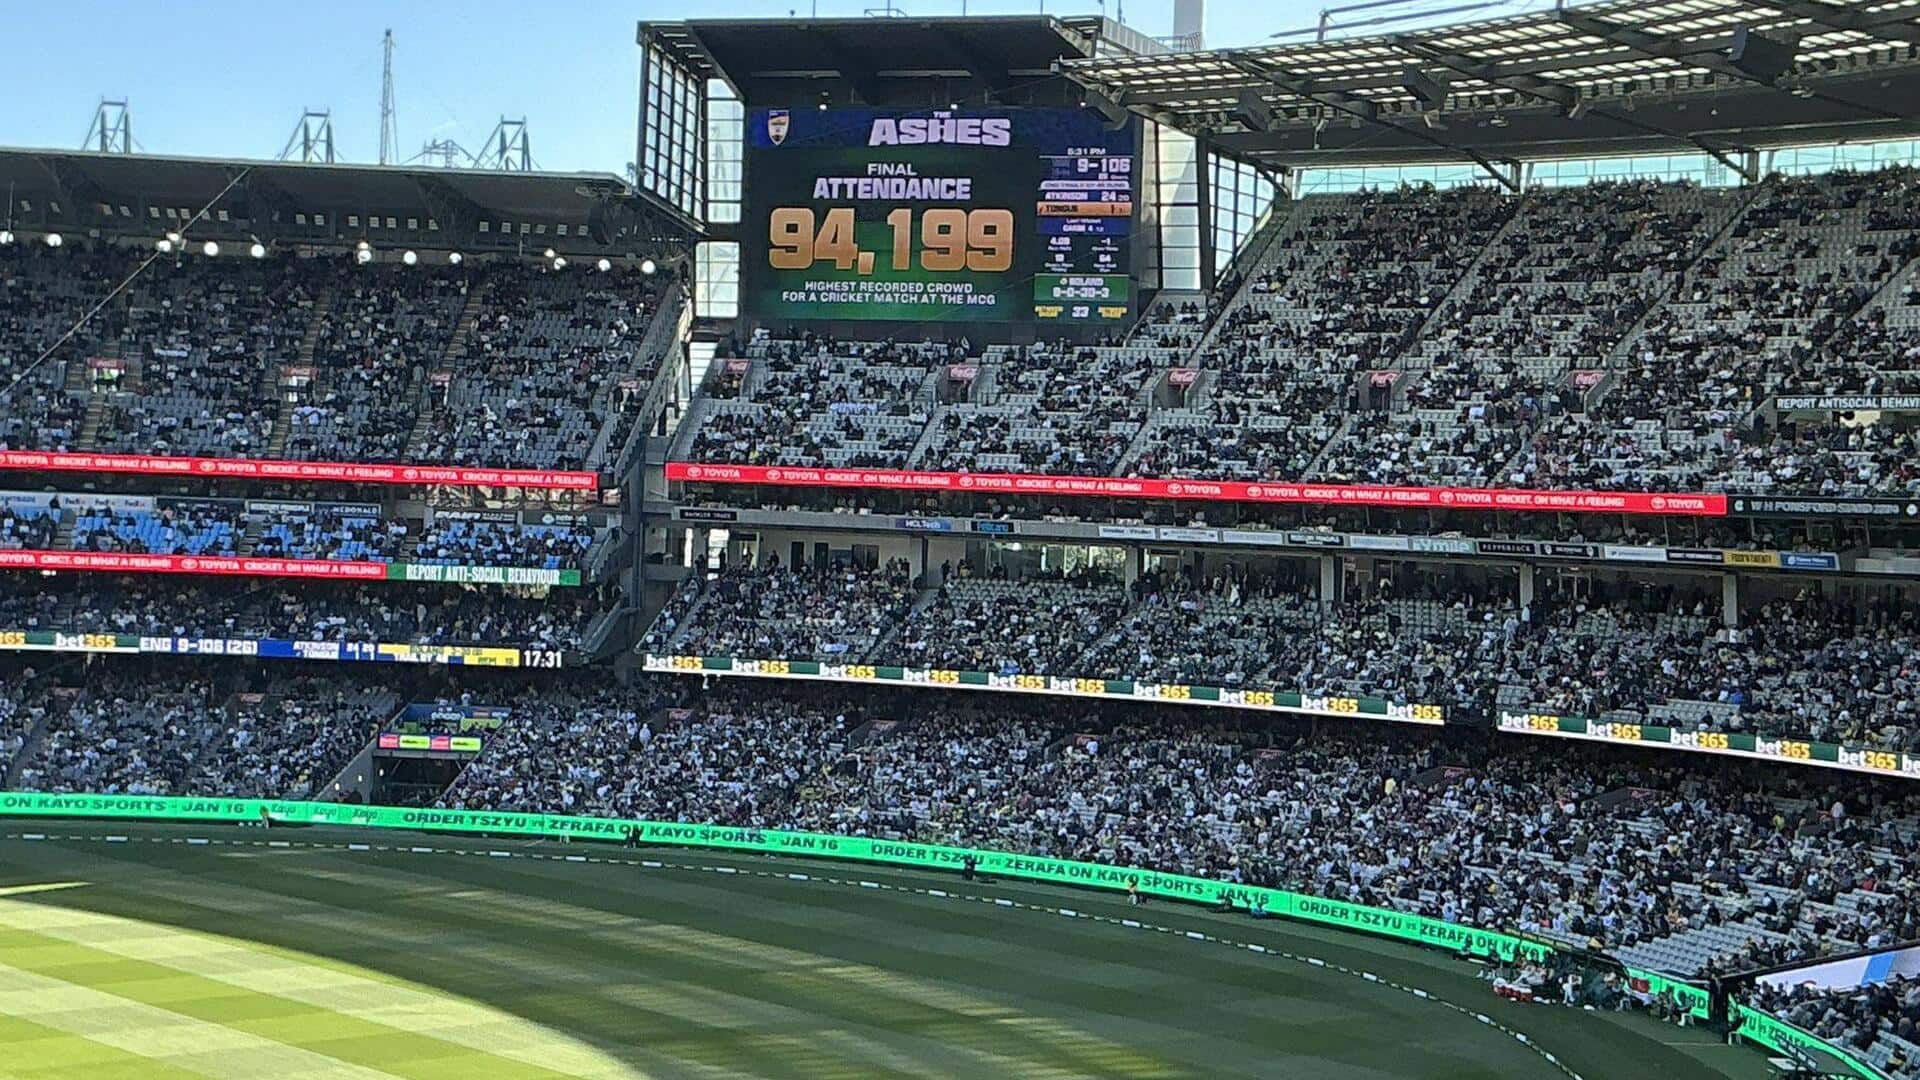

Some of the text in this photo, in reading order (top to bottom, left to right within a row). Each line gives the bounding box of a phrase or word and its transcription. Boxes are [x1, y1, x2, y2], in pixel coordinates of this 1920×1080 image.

[869, 118, 1012, 146] ASHES
[867, 163, 917, 176] FINAL
[1077, 158, 1130, 173] 9-106
[813, 178, 971, 200] ATTENDANCE
[1101, 191, 1117, 201] 24
[768, 207, 1013, 275] 94,199
[805, 281, 973, 293] HIGHEST RECORDED CROWD
[782, 291, 996, 305] FOR A CRICKET MATCH AT THE MCG
[1777, 398, 1816, 409] REPORT
[1818, 398, 1878, 409] ANTISOCIAL
[9, 456, 48, 465] TOYOTA
[111, 459, 141, 469] WHAT
[141, 460, 149, 469] A
[217, 463, 256, 472] TOYOTA
[318, 467, 345, 476] WHAT
[420, 470, 458, 480] TOYOTA
[502, 473, 515, 483] OH
[516, 474, 543, 484] WHAT
[543, 475, 551, 484] A
[704, 469, 740, 479] TOYOTA
[783, 471, 820, 481] TOYOTA
[864, 474, 877, 483] OH
[878, 474, 905, 484] WHAT
[905, 475, 912, 484] A
[976, 478, 1012, 488] TOYOTA
[1056, 481, 1069, 490] OH
[1071, 481, 1097, 491] WHAT
[1097, 482, 1104, 491] A
[1184, 485, 1221, 495] TOYOTA
[1264, 487, 1299, 498] TOYOTA
[1341, 490, 1355, 499] OH
[1356, 490, 1383, 501] WHAT
[1383, 491, 1391, 500] A
[1455, 492, 1491, 503] TOYOTA
[1550, 496, 1576, 507] WHAT
[1576, 497, 1585, 507] A
[1667, 499, 1705, 510] TOYOTA
[200, 560, 239, 570] TOYOTA
[302, 563, 331, 574] WHAT
[331, 564, 339, 573] A
[407, 565, 560, 585] REPORT ANTI-SOCIAL BEHAVIOUR
[55, 632, 117, 648] bet365
[140, 637, 171, 650] ENG
[523, 650, 562, 668] 17:31
[646, 654, 1441, 720] bet365 bet365 bet365 bet365 bet365 bet365 bet365 bet365 bet365 bet365
[1501, 711, 1559, 732] bet365
[1586, 719, 1641, 740] bet365
[1670, 728, 1729, 750] bet365
[1755, 736, 1811, 759] bet365
[1837, 746, 1897, 770] bet365
[2, 796, 246, 815] ON KAYO SPORTS JAN 16
[403, 812, 466, 826] ORDER
[469, 815, 527, 829] TSZYU
[549, 821, 615, 836] ZERAFA
[650, 825, 696, 840] KAYO
[702, 829, 768, 845] SPORTS
[780, 836, 815, 850] JAN
[819, 838, 838, 851] 16
[872, 842, 927, 861] ORDER
[1005, 858, 1066, 877] ZERAFA
[1068, 865, 1093, 880] ON
[1142, 873, 1204, 896] SPORTS
[1299, 899, 1349, 920] ORDER
[1353, 910, 1402, 931] TSZYU
[1420, 922, 1473, 948] ZERAFA
